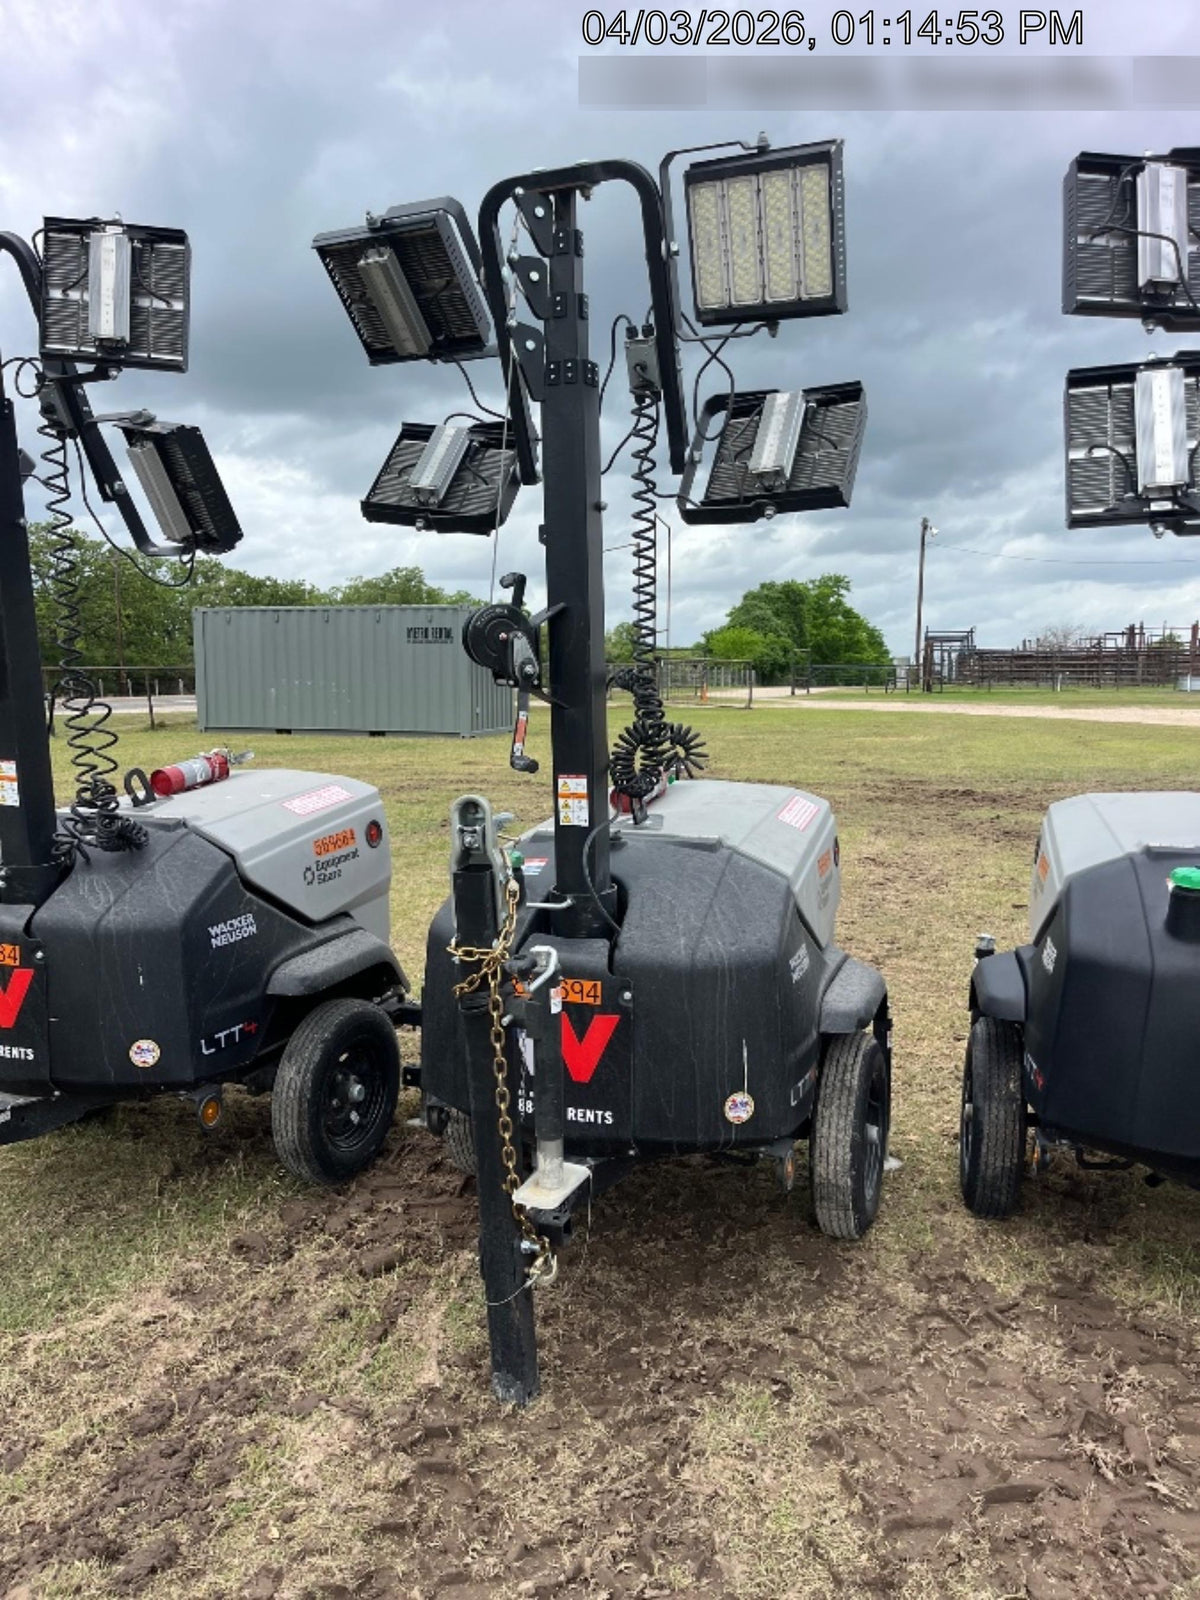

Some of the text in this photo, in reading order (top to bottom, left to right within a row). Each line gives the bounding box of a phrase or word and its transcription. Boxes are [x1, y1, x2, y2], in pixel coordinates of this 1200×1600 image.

[207, 913, 255, 938] WACKER
[210, 923, 257, 949] NEUSON
[200, 1021, 258, 1055] LTT4
[566, 1107, 614, 1125] RENTS
